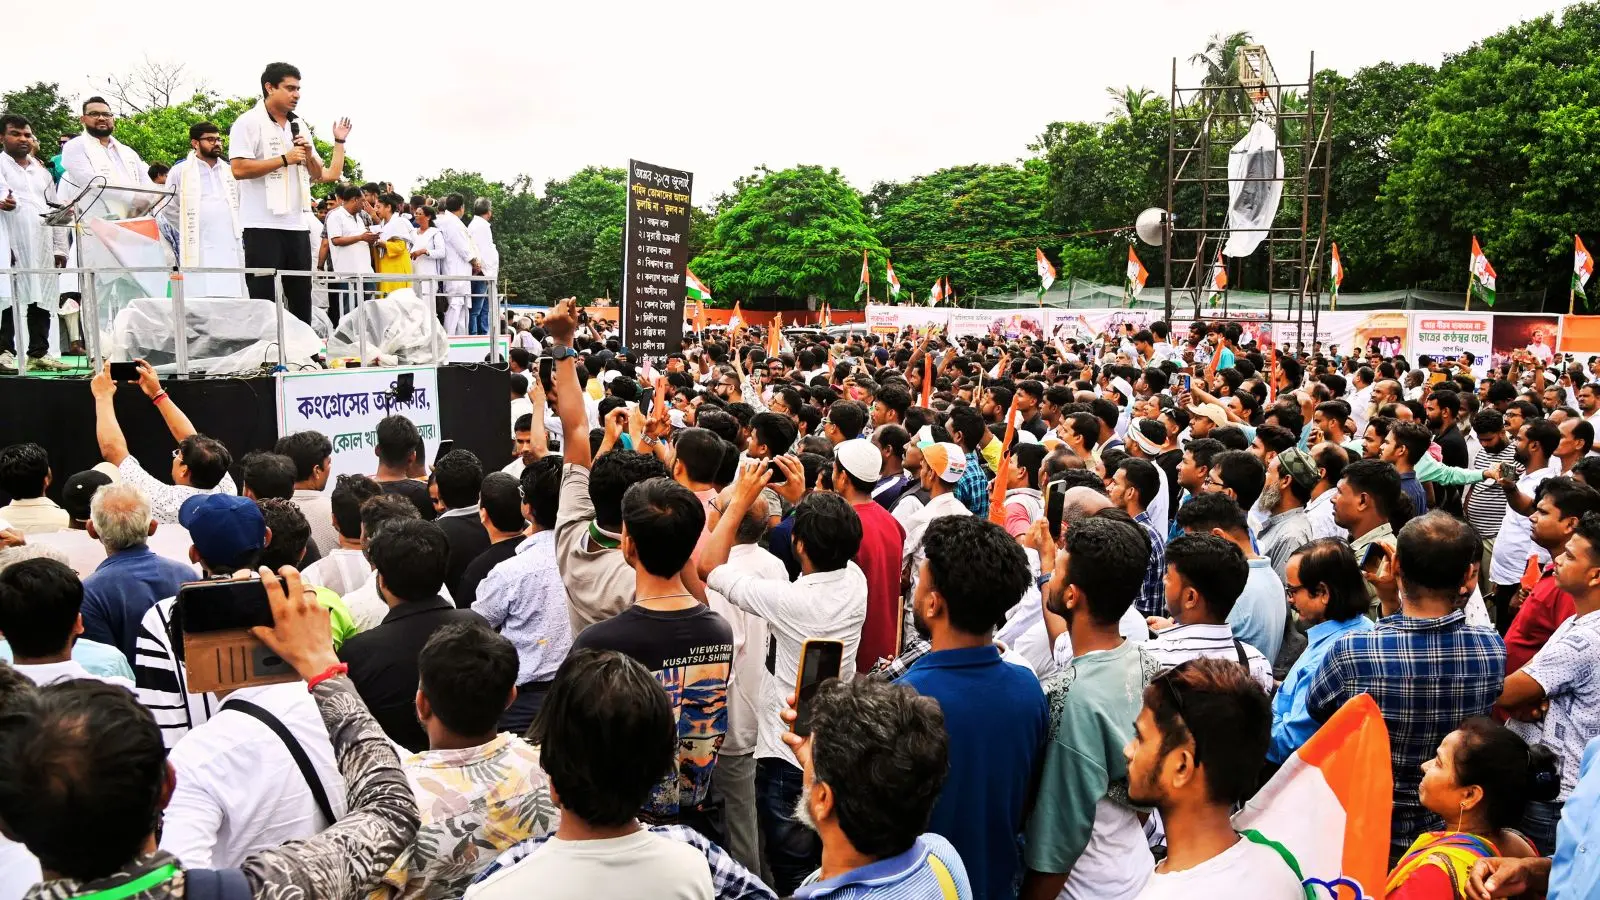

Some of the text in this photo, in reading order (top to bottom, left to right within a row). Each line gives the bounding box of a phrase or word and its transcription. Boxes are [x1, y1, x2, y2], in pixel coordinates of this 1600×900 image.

[671, 171, 690, 192] জুলাই
[647, 188, 672, 201] তোমাদের
[674, 192, 690, 204] আমরা
[652, 202, 660, 212] না
[678, 206, 685, 216] না
[659, 219, 669, 228] দাস
[645, 245, 658, 254] রতন
[645, 256, 664, 268] বিশ্বনাথ
[664, 261, 674, 269] রায়
[644, 285, 658, 295] অসীম
[658, 288, 668, 296] দাস
[644, 301, 659, 309] কেশব
[659, 300, 676, 310] বৈরাগী
[643, 312, 658, 323] দিলীপ
[658, 315, 667, 323] দাস
[642, 326, 656, 337] রঞ্জিত
[657, 329, 666, 337] দাস
[1419, 332, 1441, 343] ছাত্রের
[1442, 331, 1469, 343] কণ্ঠস্বর
[642, 340, 656, 350] প্রদীপ
[656, 342, 665, 350] রায়
[296, 391, 369, 420] কংগ্রেসের
[333, 432, 363, 454] কোল
[689, 644, 719, 655] VIEWS
